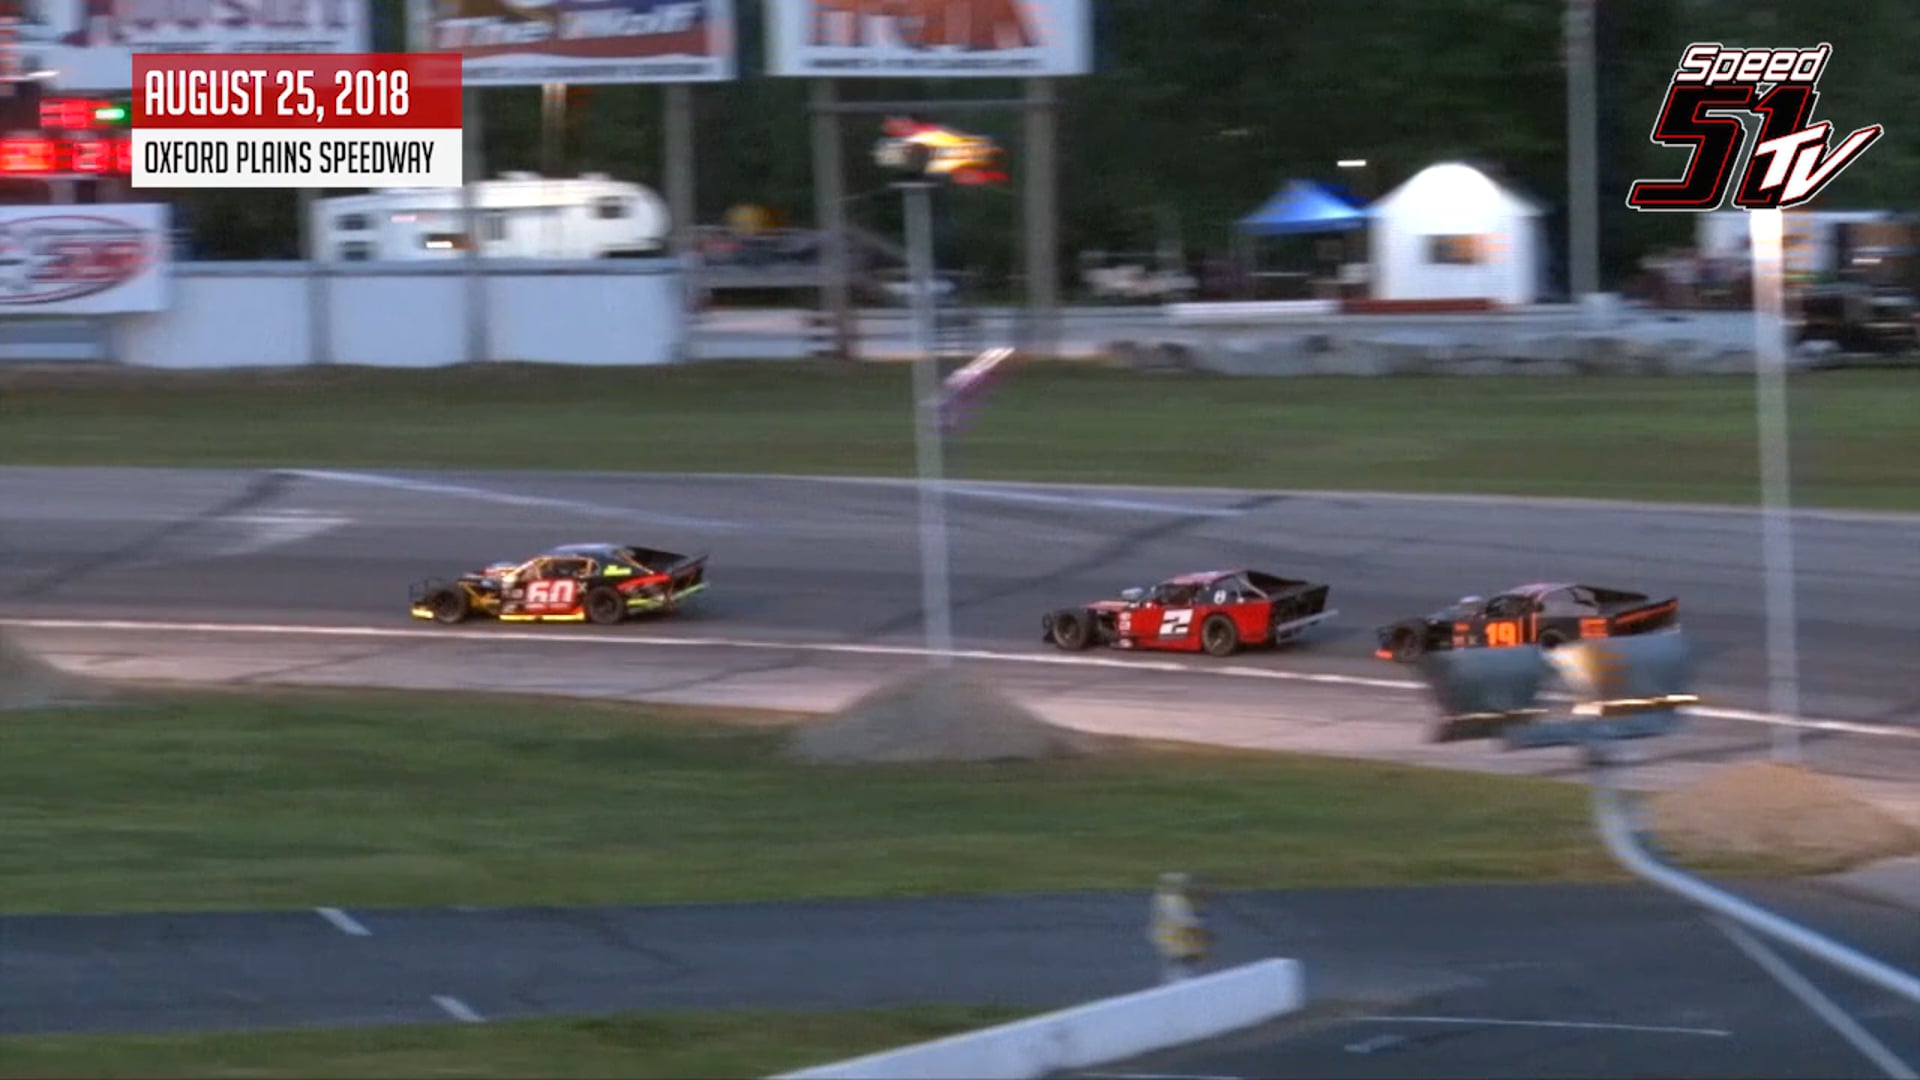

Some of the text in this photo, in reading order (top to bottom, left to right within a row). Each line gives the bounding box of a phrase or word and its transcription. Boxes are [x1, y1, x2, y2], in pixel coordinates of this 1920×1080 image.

[525, 579, 576, 604] 60
[1159, 608, 1194, 635] 2
[1484, 621, 1518, 648] 19
